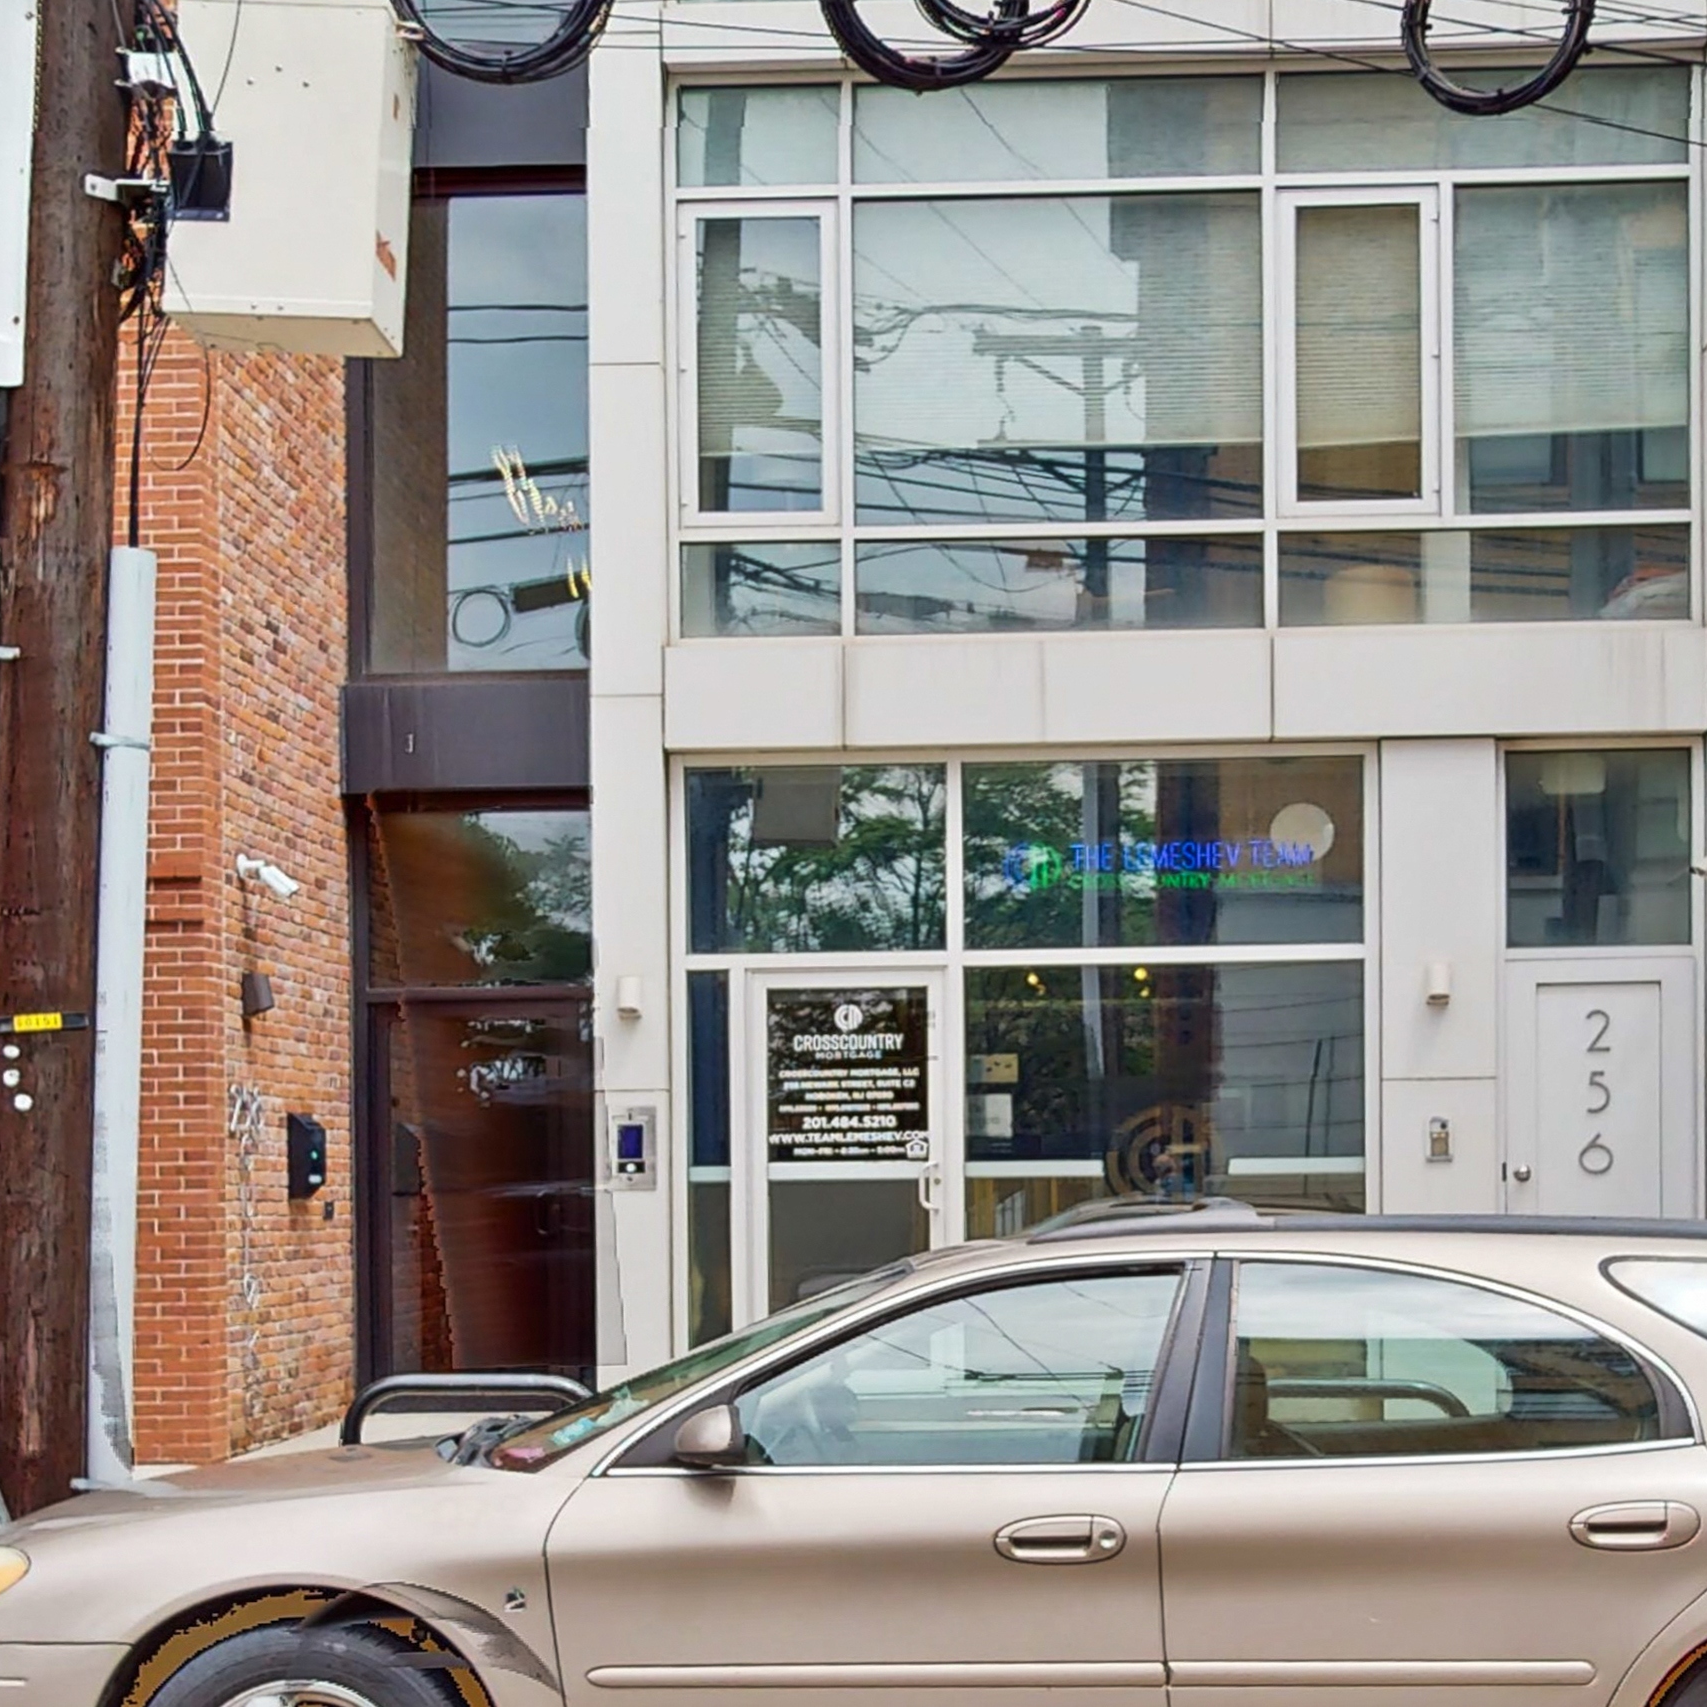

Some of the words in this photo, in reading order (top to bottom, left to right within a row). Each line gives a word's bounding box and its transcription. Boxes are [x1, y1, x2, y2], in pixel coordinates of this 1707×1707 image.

[1070, 843, 1113, 871] THE
[1122, 841, 1240, 872] LEMESHEV
[1249, 839, 1315, 869] TEAM
[793, 1033, 904, 1052] CROSSCOUNTRY
[815, 1050, 883, 1060] MORTGAGE
[1578, 1008, 1614, 1175] 256
[801, 1115, 898, 1130] 201.484.5210
